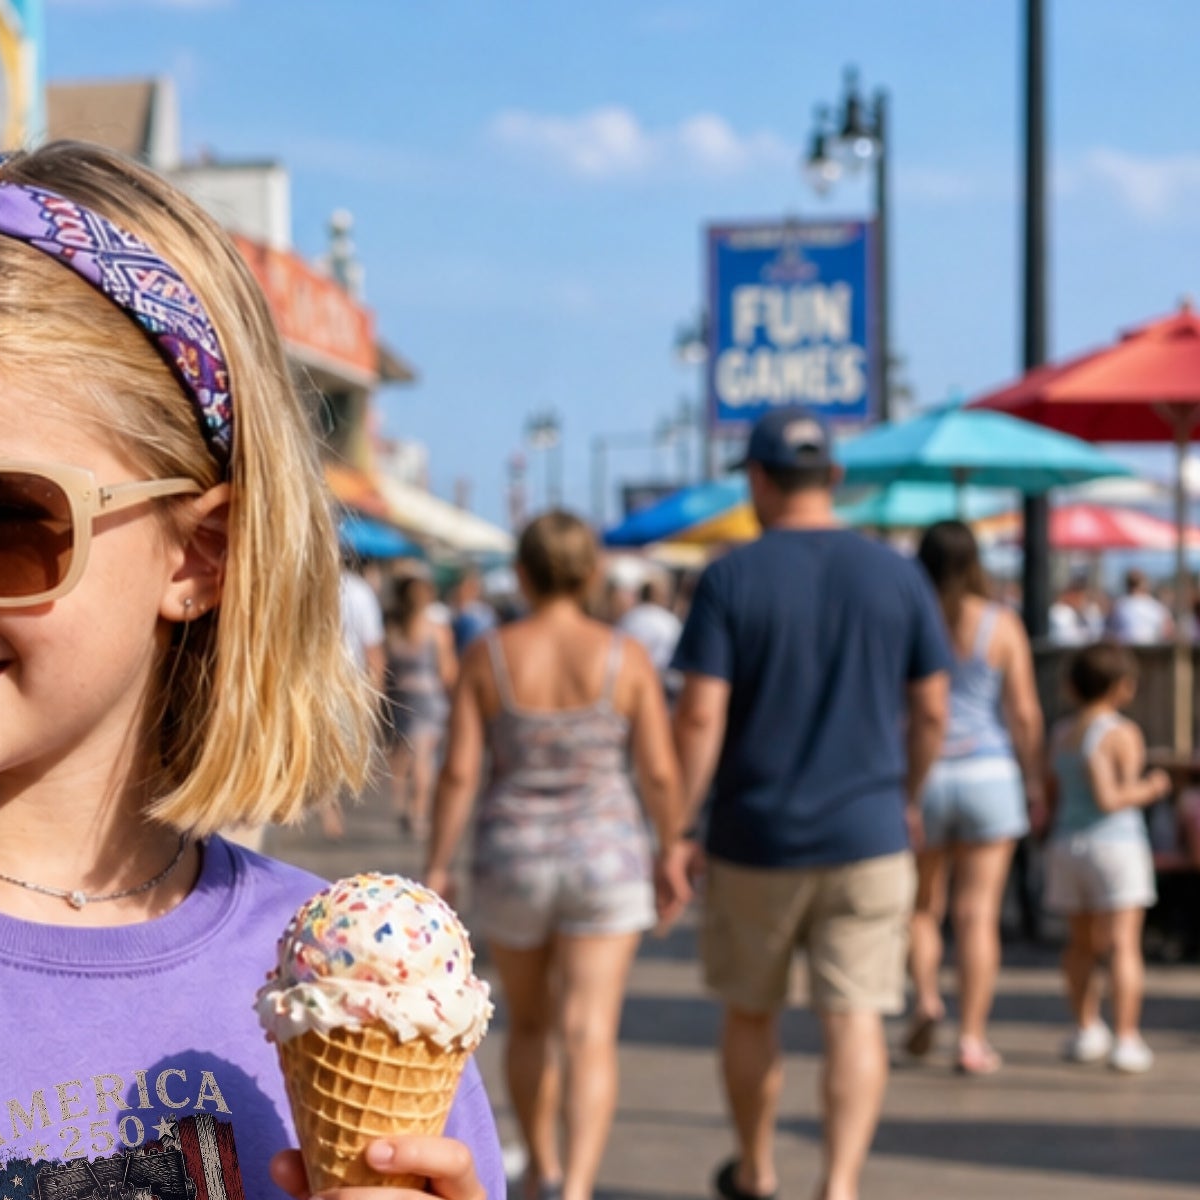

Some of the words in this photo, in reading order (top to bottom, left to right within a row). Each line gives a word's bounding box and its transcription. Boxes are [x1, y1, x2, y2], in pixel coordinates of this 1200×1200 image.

[732, 281, 852, 347] FUN
[716, 345, 866, 407] GAMES
[59, 1115, 145, 1158] 250
